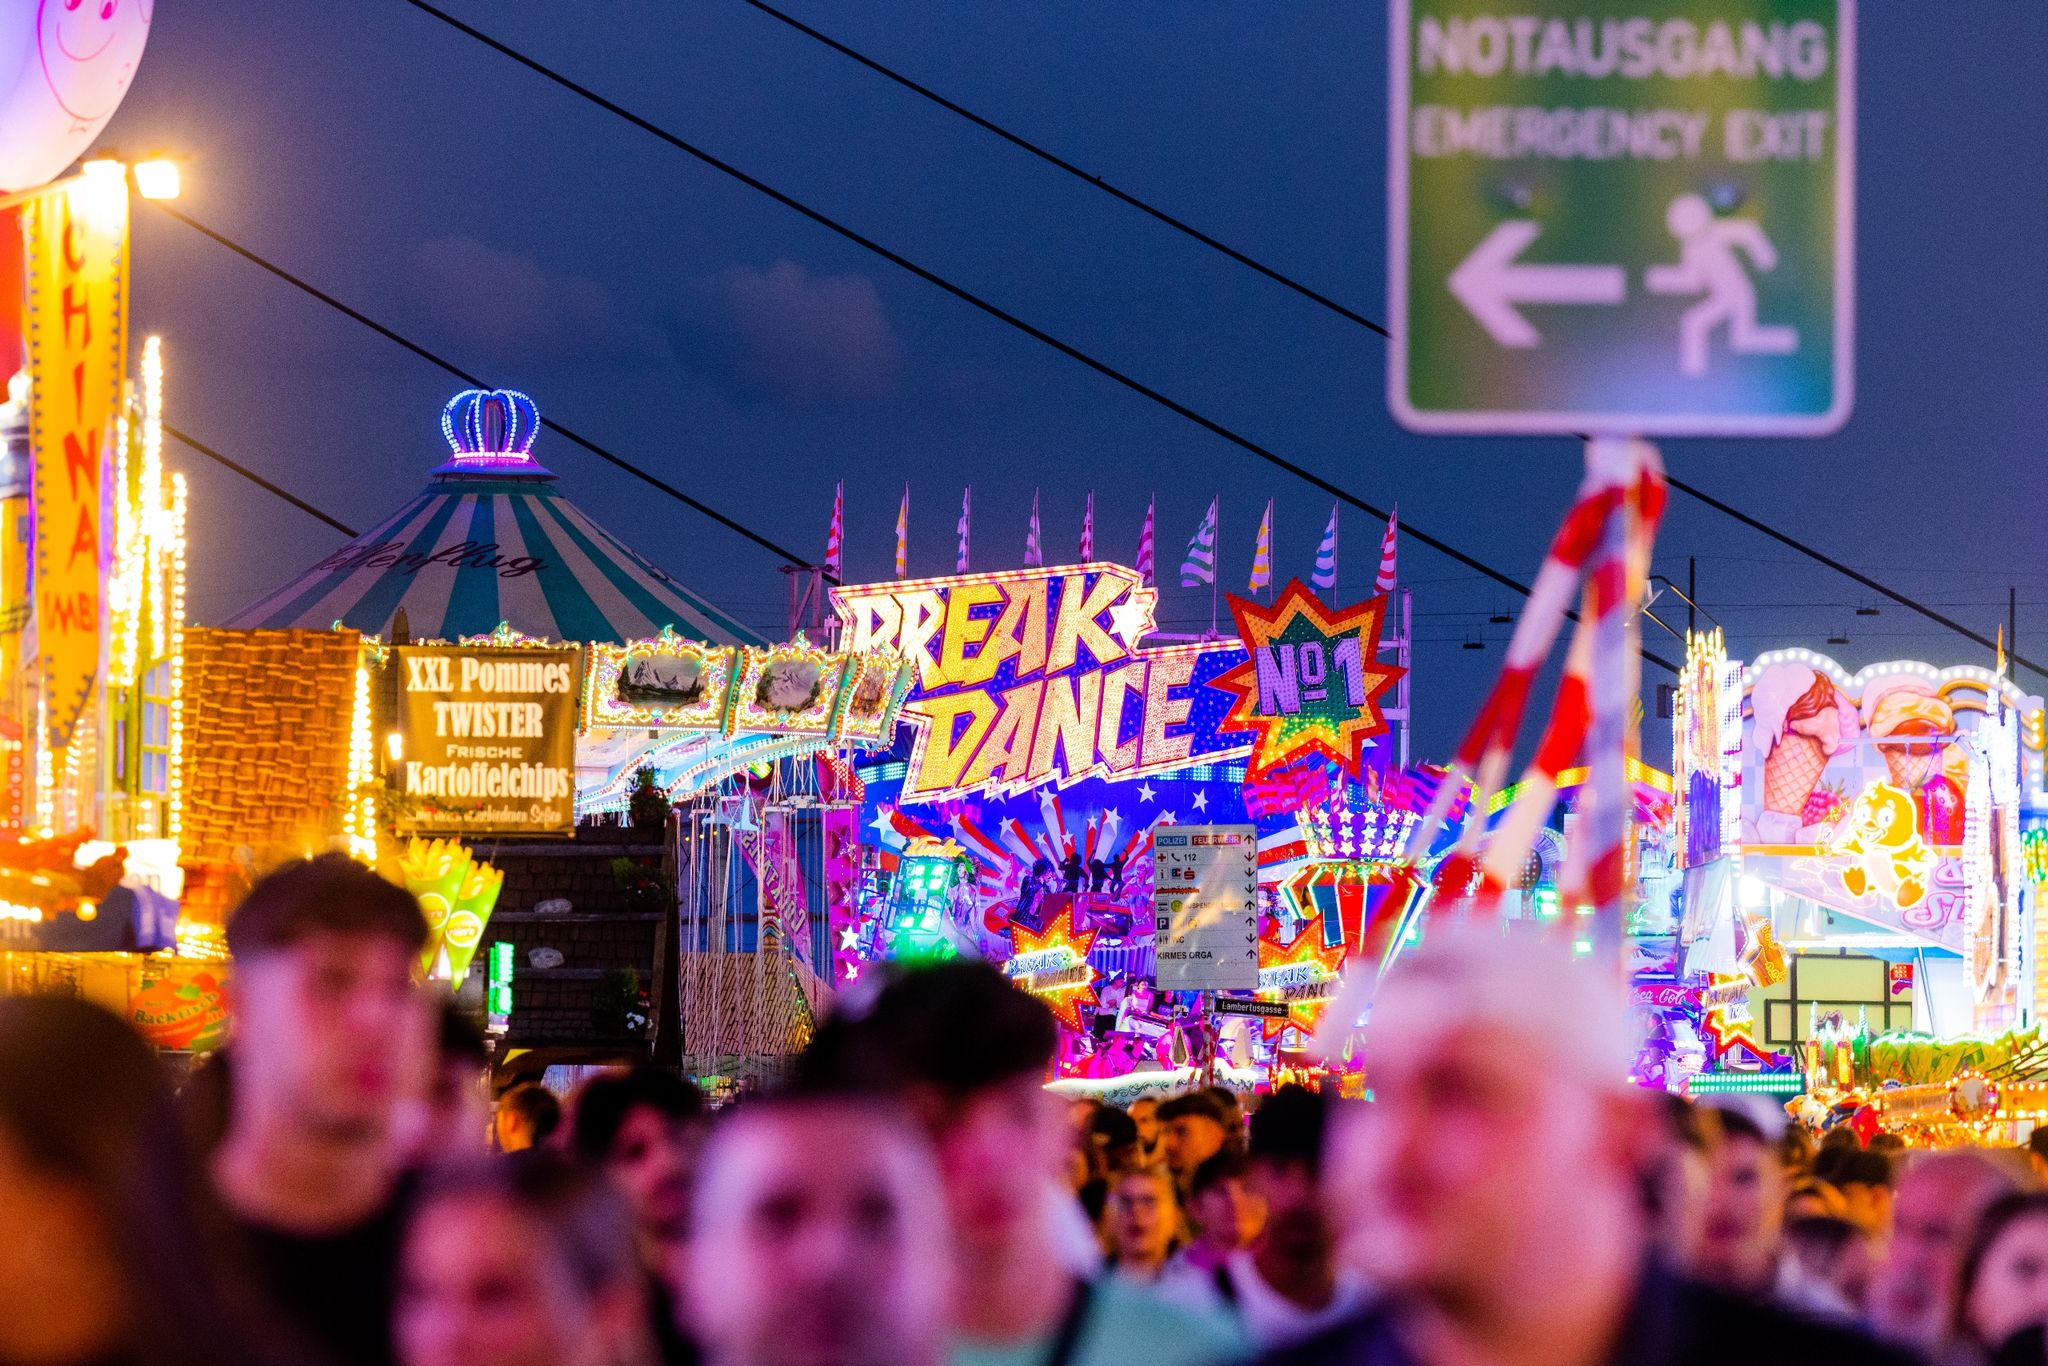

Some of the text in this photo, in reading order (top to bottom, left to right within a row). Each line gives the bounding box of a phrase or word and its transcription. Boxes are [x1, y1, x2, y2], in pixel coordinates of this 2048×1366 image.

[1417, 16, 1828, 80] NOTAUSGANG
[1413, 107, 1826, 161] EMERGENCY EXIT
[62, 222, 98, 574] CHINA
[844, 571, 1136, 692] BREAK
[406, 656, 571, 693] XXL Pommes
[433, 701, 544, 738] TWISTER
[902, 655, 1197, 792] DANCE
[405, 761, 569, 803] Kartoffelchips
[1158, 835, 1240, 845] POLIZEI FEUERWEHR
[1184, 853, 1197, 861] 112
[1157, 951, 1213, 960] KIRMES ORGA
[1222, 1001, 1282, 1014] Lambertusgasse
